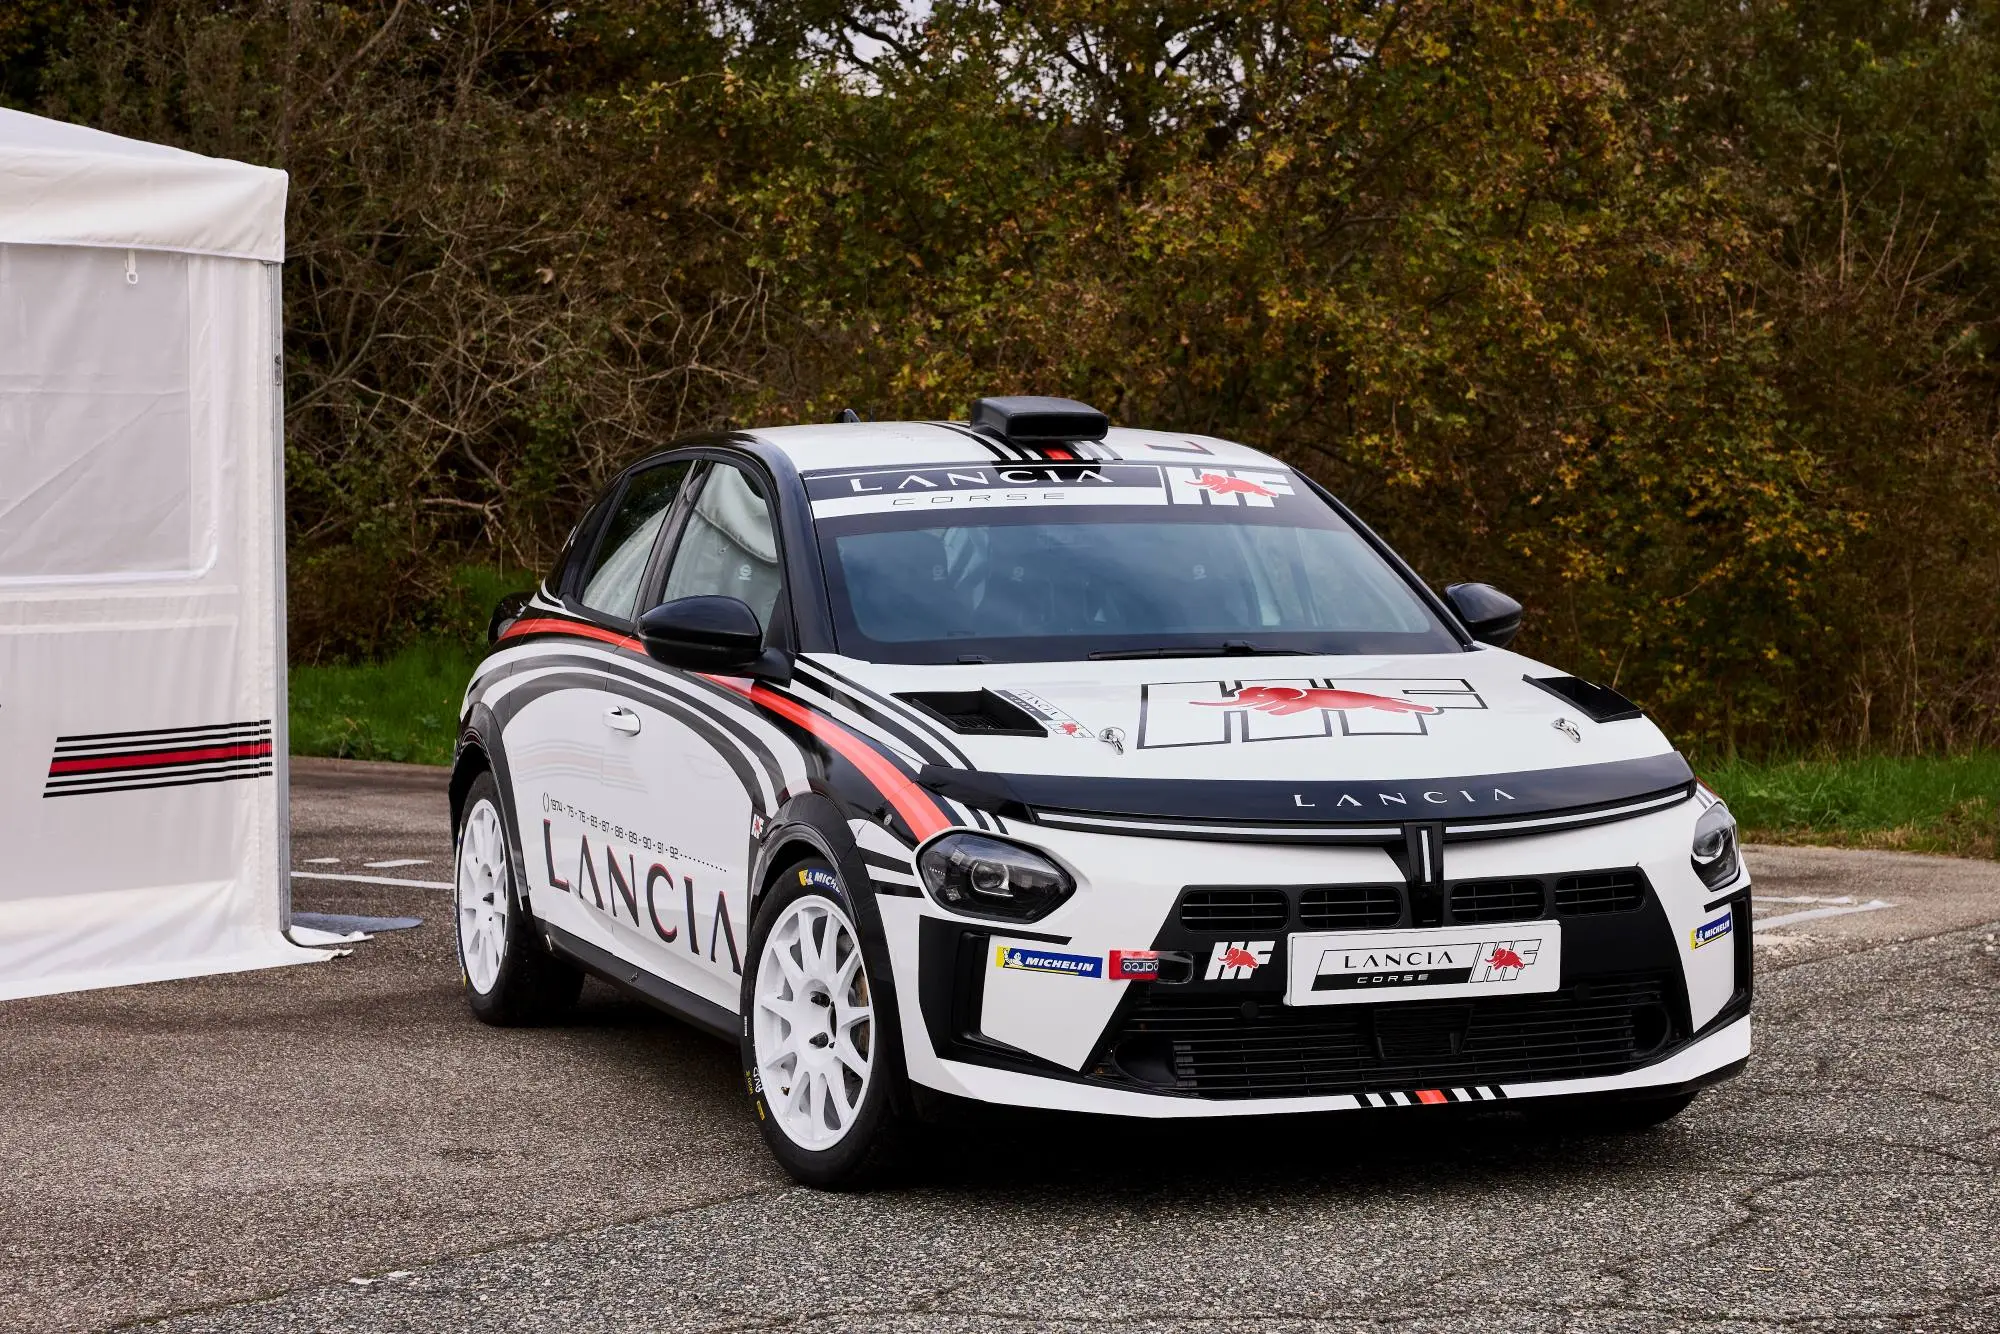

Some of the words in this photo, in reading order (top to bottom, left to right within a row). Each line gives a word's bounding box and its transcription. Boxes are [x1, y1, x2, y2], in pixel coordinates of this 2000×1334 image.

[850, 470, 1114, 492] LANCIA
[893, 492, 1065, 505] CORSE
[1293, 788, 1516, 808] LANCIA
[543, 818, 743, 977] LANCIA
[1705, 919, 1730, 939] MICHELIN
[1025, 956, 1095, 972] MICHELIN
[1344, 951, 1453, 969] LANCIA
[1357, 973, 1430, 984] CORSE
